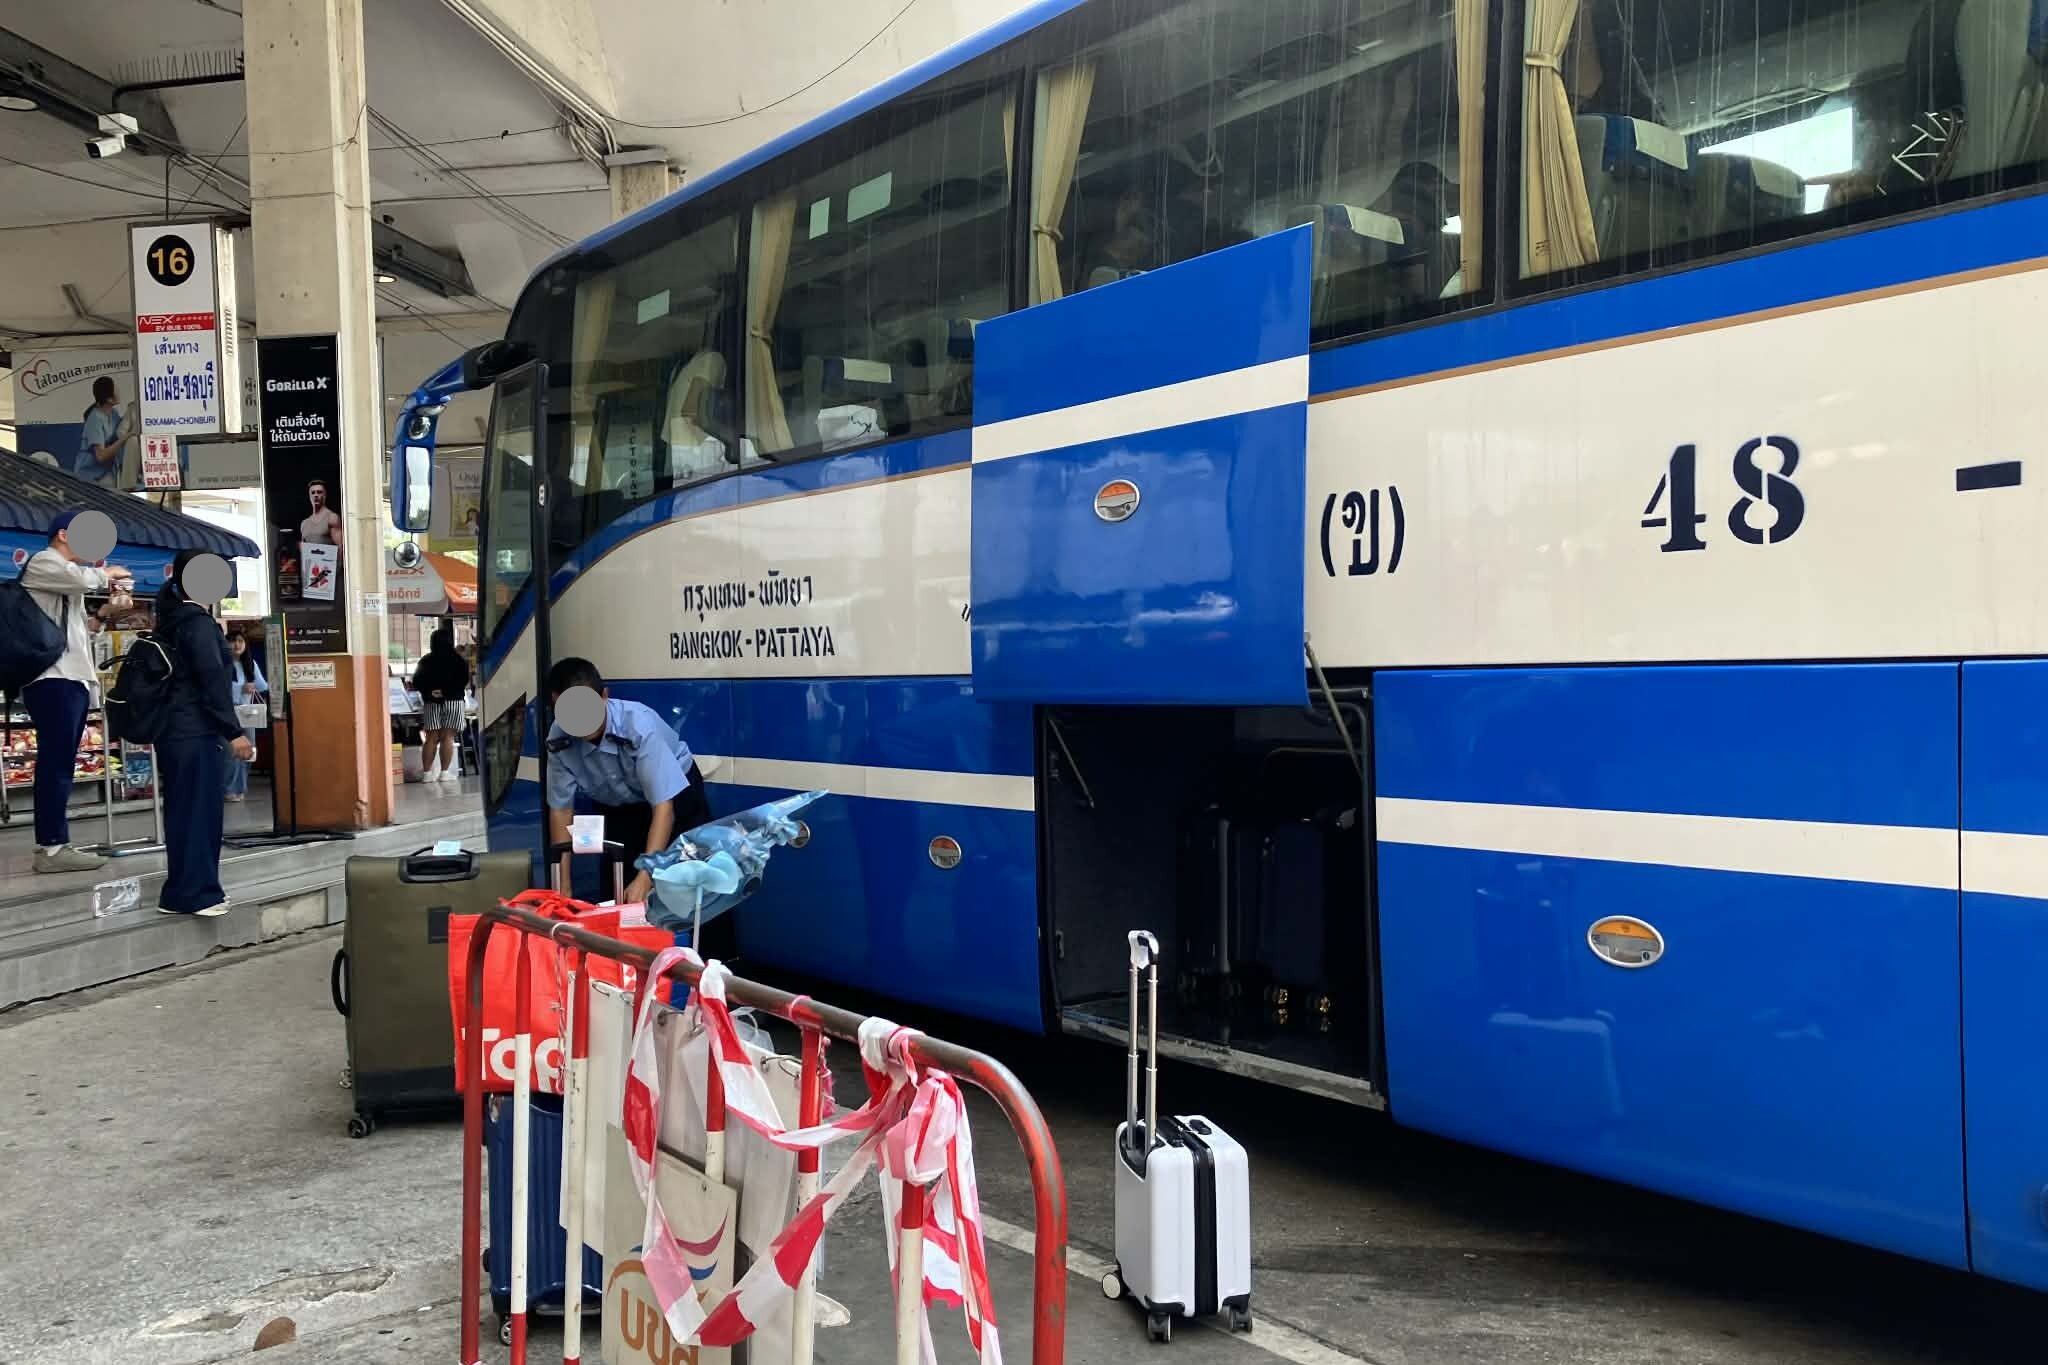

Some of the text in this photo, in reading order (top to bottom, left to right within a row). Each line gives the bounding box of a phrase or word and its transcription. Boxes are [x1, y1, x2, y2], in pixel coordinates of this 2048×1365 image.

[151, 247, 189, 276] 16
[139, 314, 175, 326] NEX
[154, 336, 199, 355] เส้นทาง
[144, 361, 214, 412] เอกมัย-ชลบุรี
[145, 415, 216, 427] EKKAMAI-CHONBURI
[275, 411, 325, 429] เติมสิ่งดีๆ
[270, 428, 331, 443] ให้กับตัวเอง
[147, 473, 179, 486] ตรงไป
[1641, 435, 1805, 553] 48
